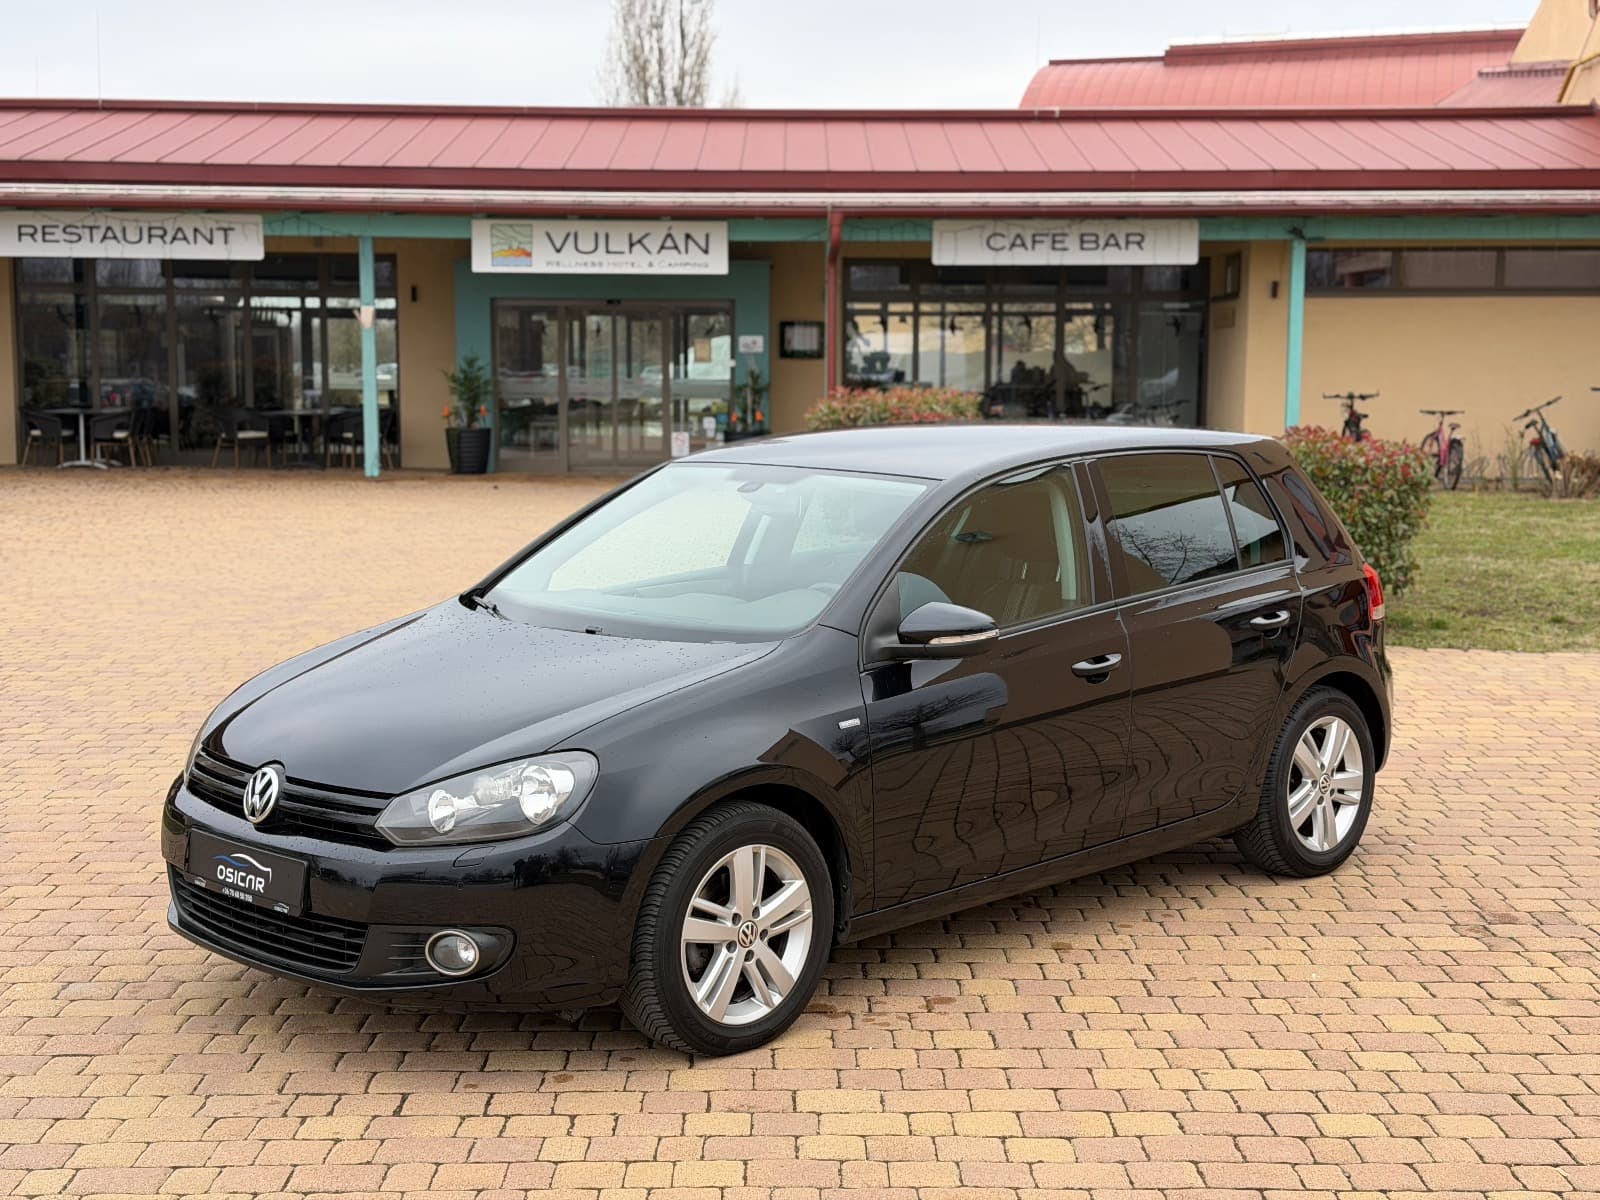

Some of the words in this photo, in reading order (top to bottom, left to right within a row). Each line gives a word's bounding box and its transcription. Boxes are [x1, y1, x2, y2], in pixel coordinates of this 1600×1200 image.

[17, 224, 236, 245] RESTAURANT
[544, 226, 711, 256] VULKÁN
[985, 232, 1070, 252] CAFE
[1078, 232, 1146, 252] BAR
[216, 864, 265, 893] OSICAR
